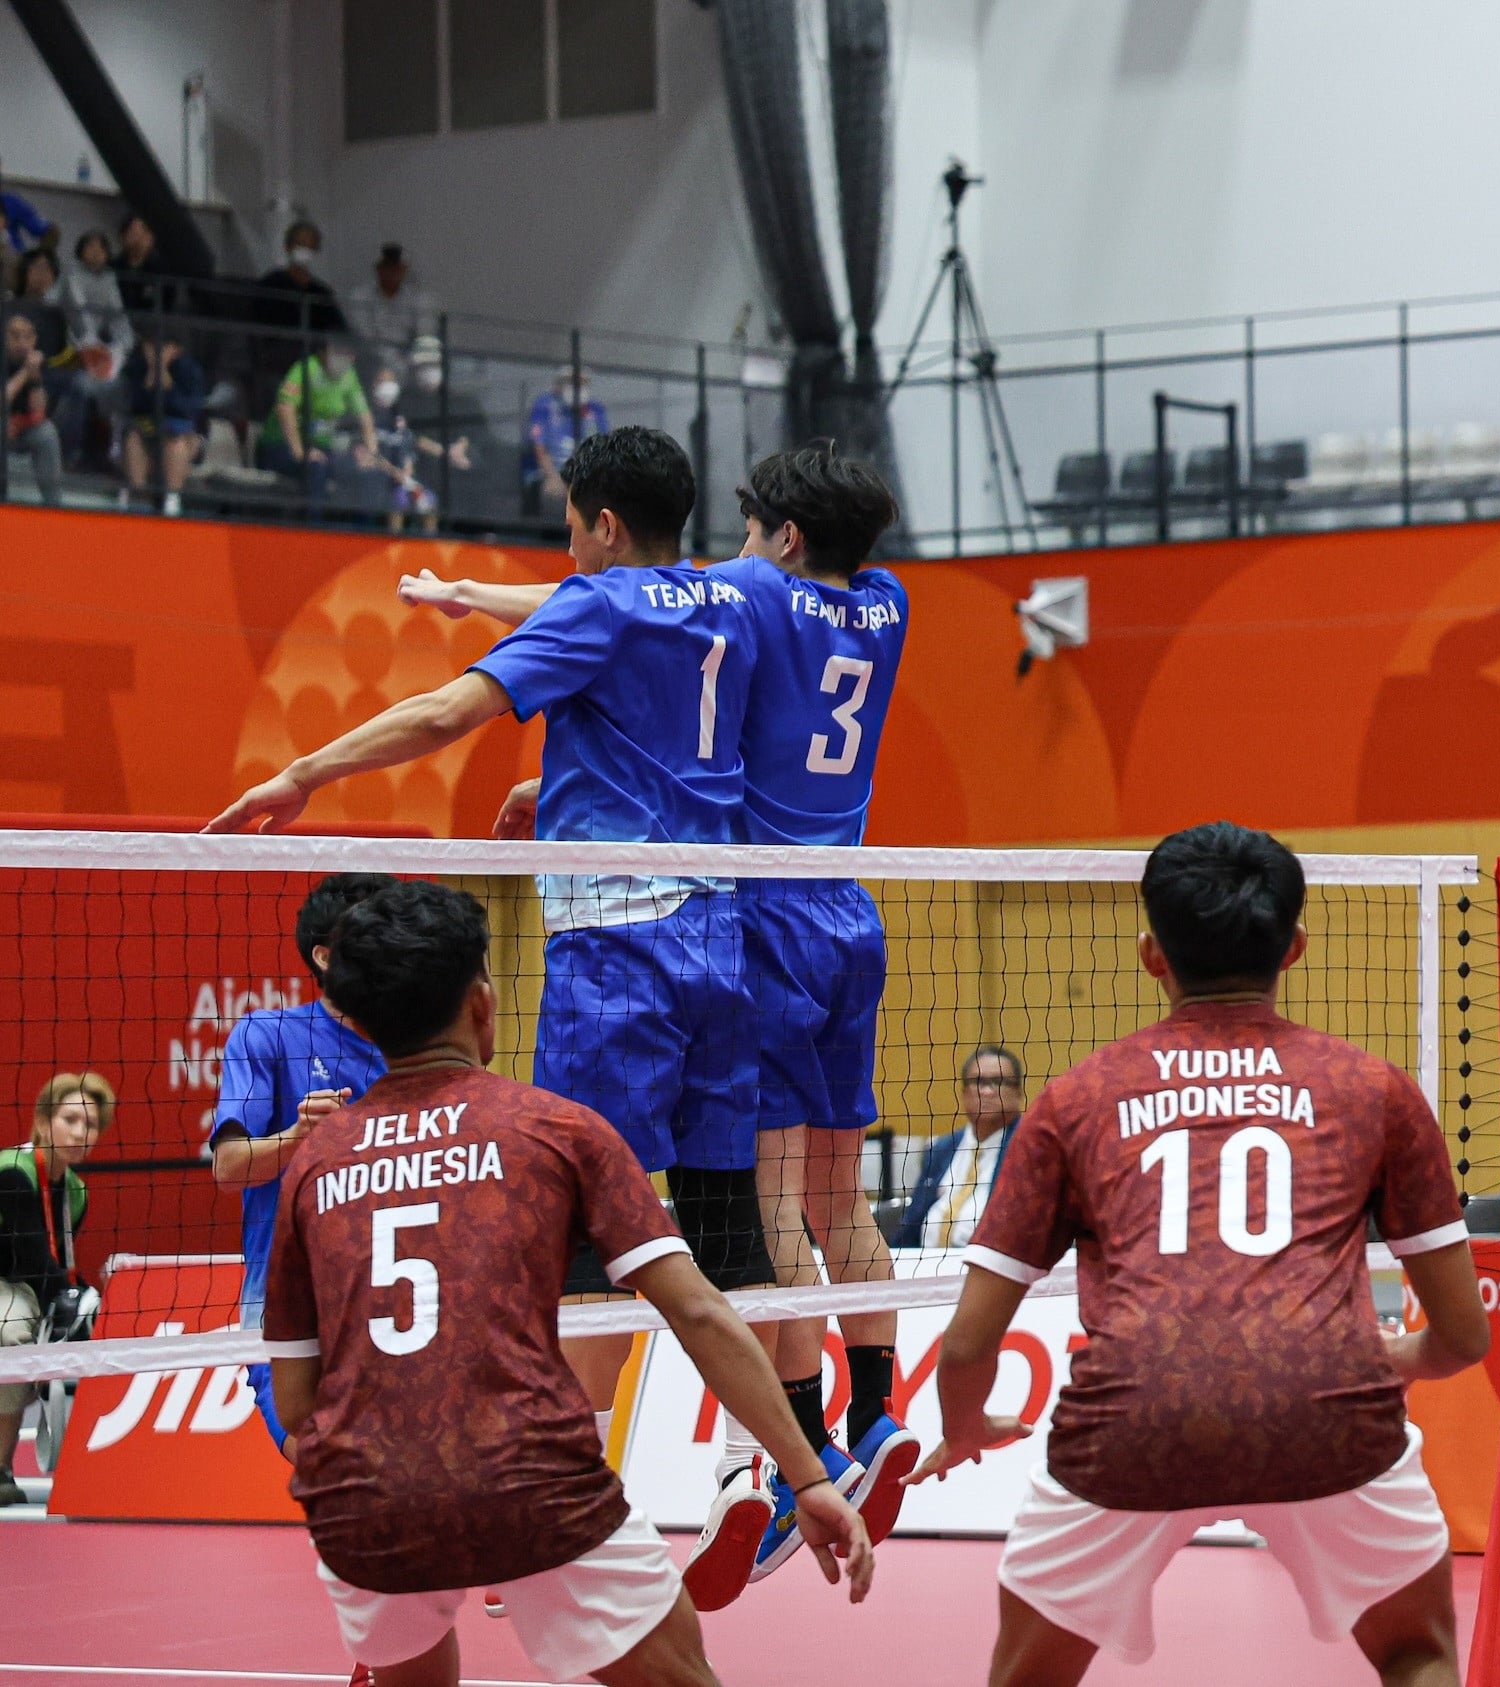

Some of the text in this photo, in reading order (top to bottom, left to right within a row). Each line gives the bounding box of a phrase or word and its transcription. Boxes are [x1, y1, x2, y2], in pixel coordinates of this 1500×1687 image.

[641, 581, 706, 608] TEAM
[791, 589, 846, 628] TEAM
[697, 635, 726, 759] 1
[805, 655, 873, 775] 3
[1151, 1047, 1283, 1081] YUDHA
[352, 1102, 468, 1152] JELKY
[1117, 1083, 1315, 1140] INDONESIA
[315, 1141, 504, 1216] INDONESIA
[1140, 1126, 1293, 1257] 10
[367, 1201, 440, 1357] 5
